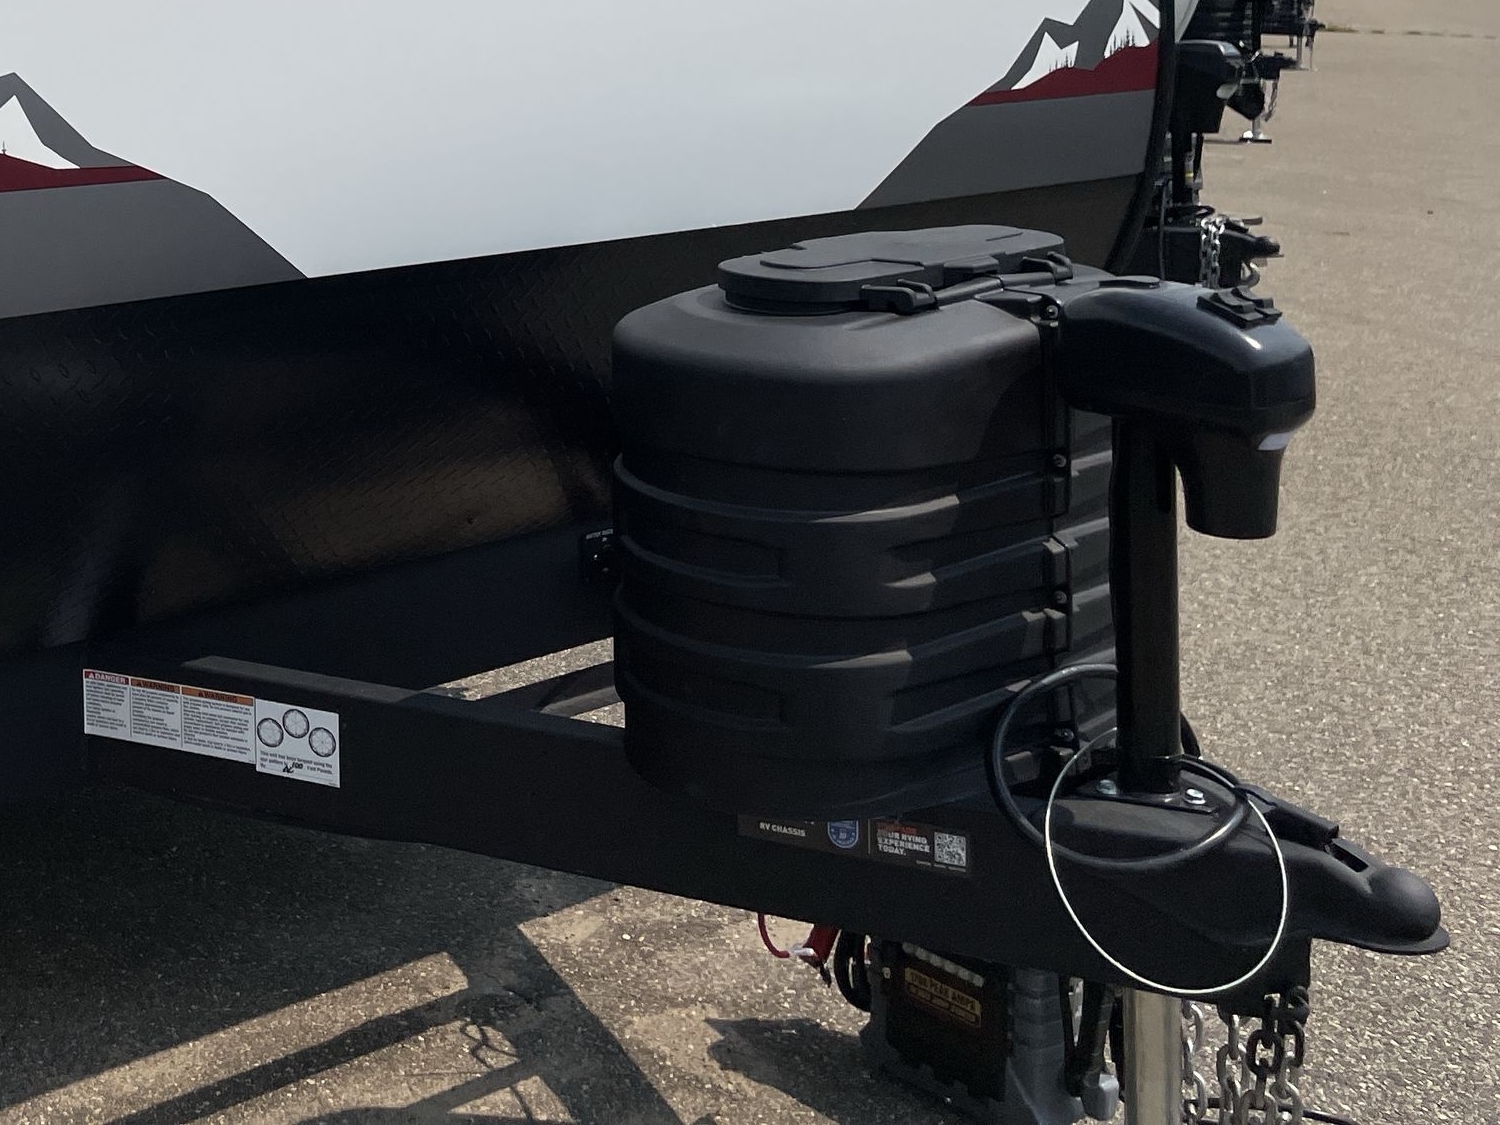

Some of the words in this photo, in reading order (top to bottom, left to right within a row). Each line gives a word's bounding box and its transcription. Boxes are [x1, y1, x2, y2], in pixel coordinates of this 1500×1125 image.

[760, 822, 771, 830] RV
[771, 824, 806, 837] CHASSIS
[878, 843, 907, 856] TODAY.
